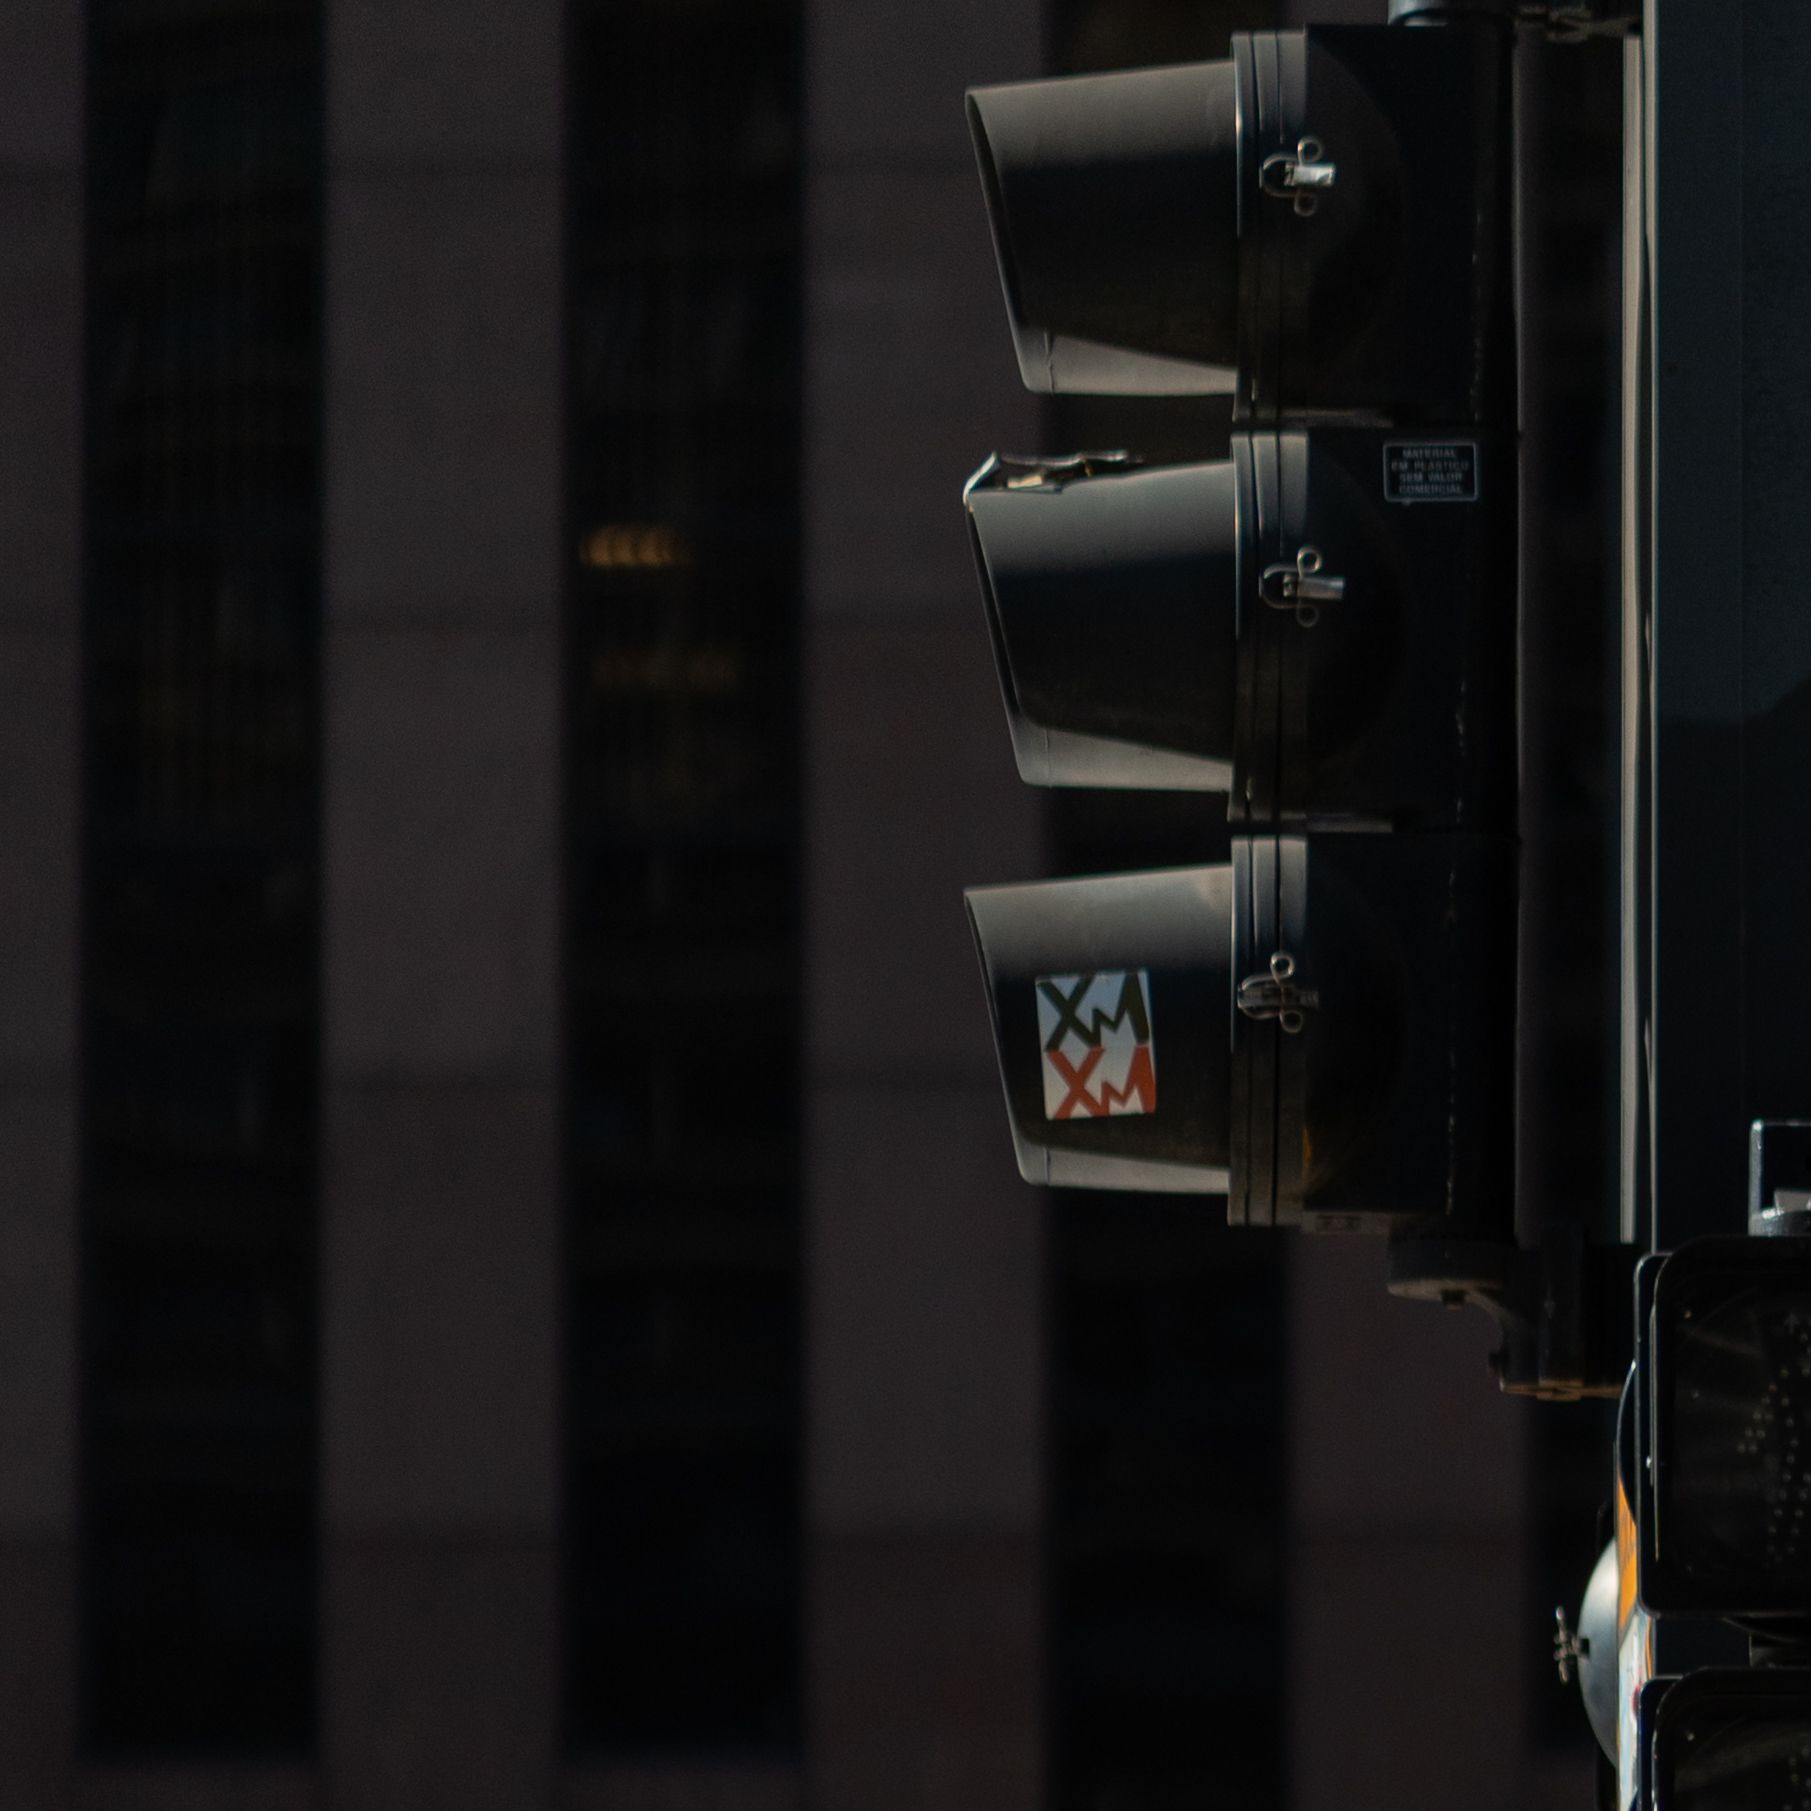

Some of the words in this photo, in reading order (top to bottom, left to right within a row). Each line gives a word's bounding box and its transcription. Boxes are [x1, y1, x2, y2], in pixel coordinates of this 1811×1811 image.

[1402, 448, 1456, 459] MATERIAL
[1391, 460, 1408, 471] EM
[1399, 472, 1423, 482] SEM
[1428, 472, 1463, 482] VALOR
[1399, 484, 1463, 495] COMERCIAL
